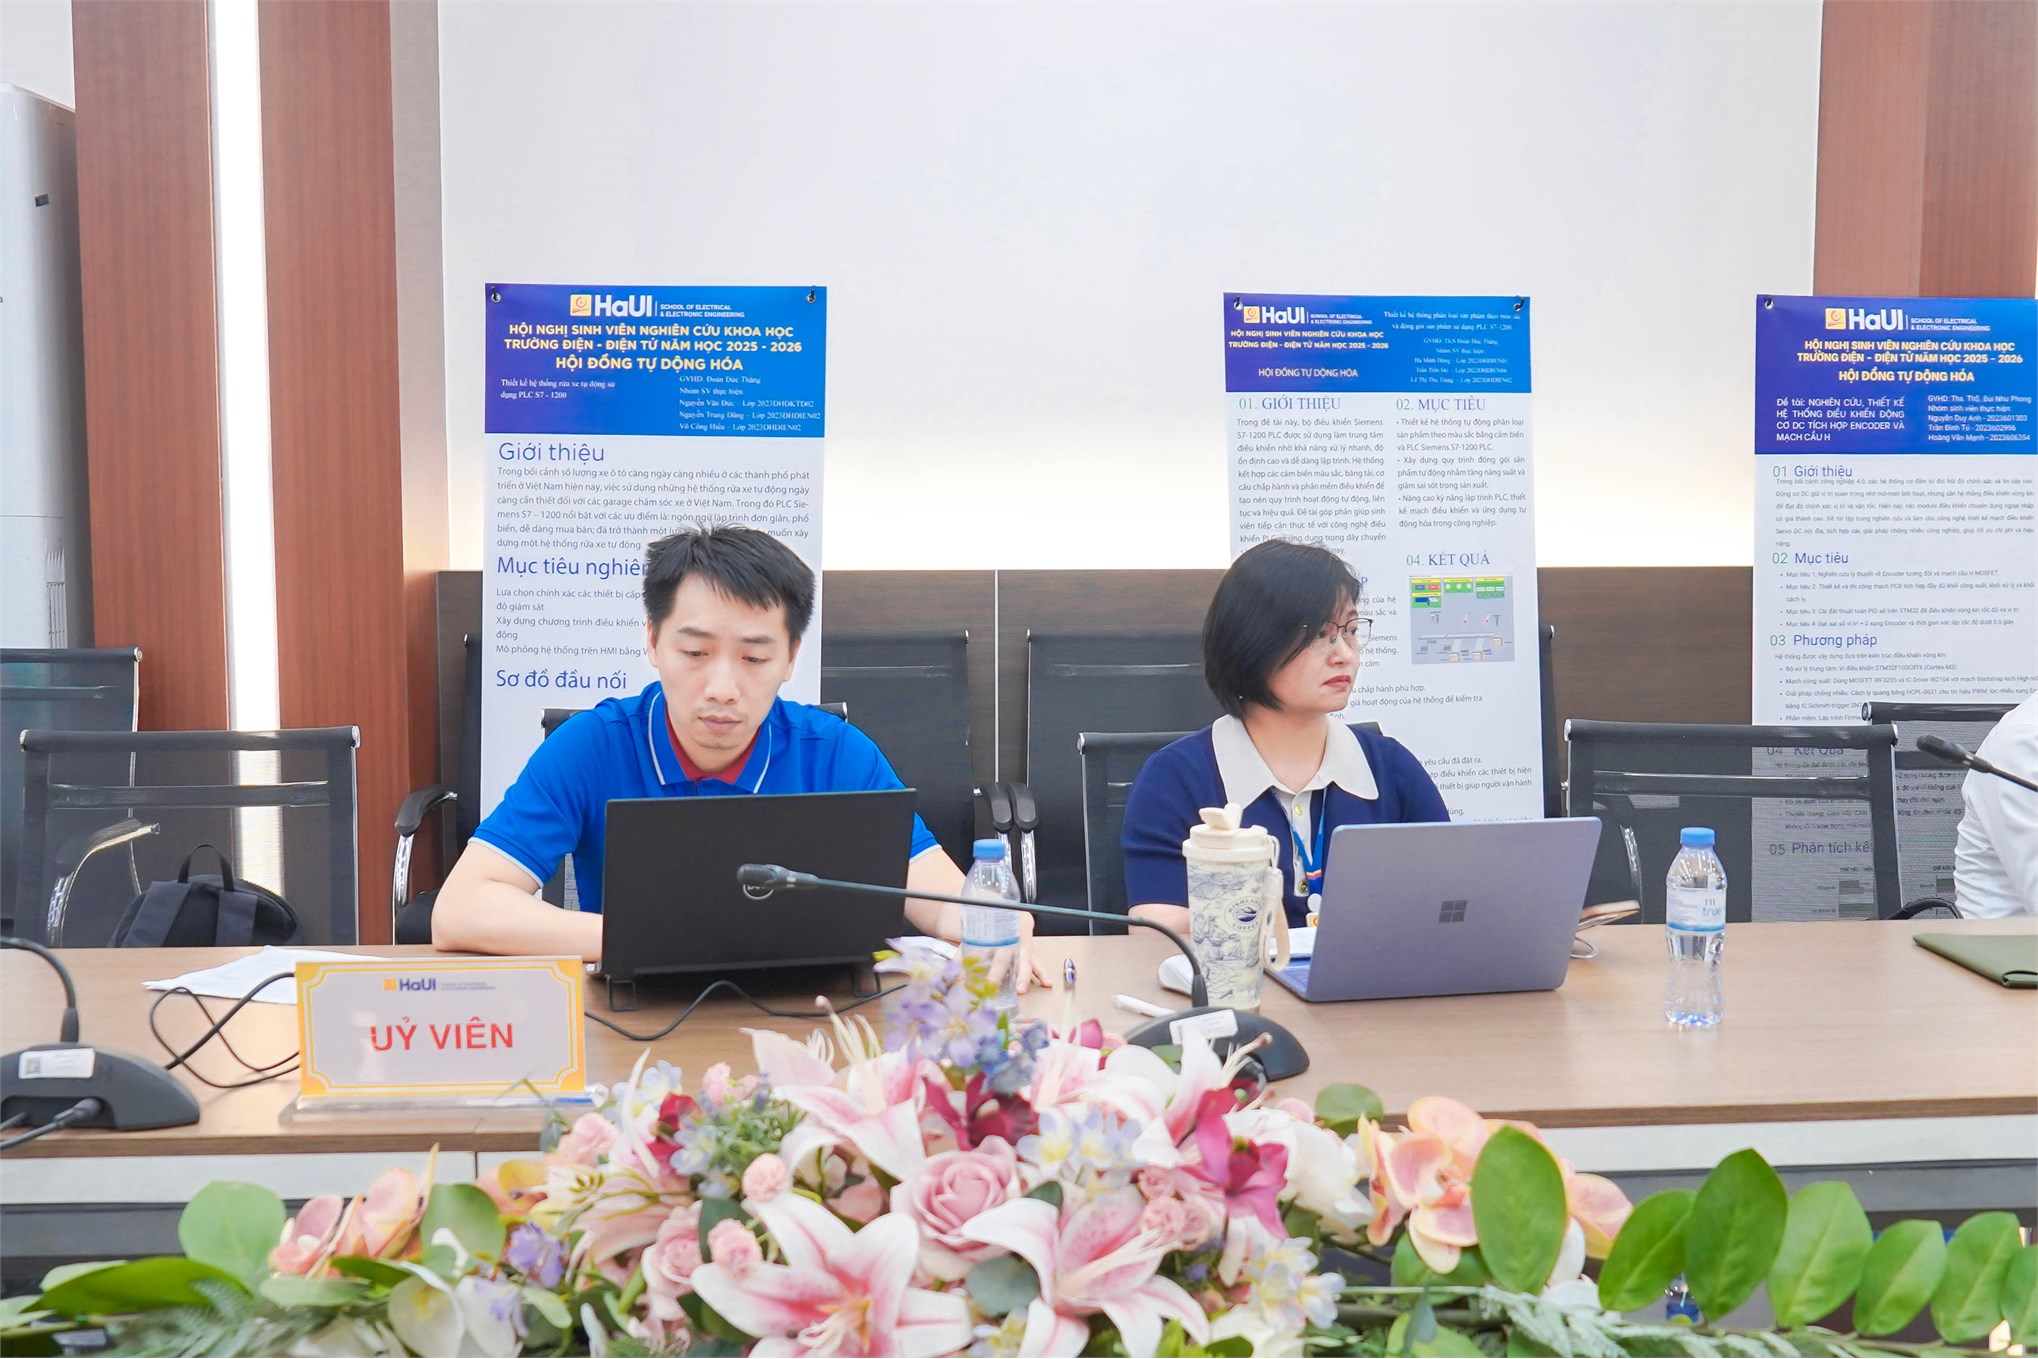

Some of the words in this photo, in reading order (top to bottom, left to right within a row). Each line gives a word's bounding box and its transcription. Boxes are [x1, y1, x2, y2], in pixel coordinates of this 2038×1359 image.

[595, 295, 652, 317] HaUI
[1262, 306, 1305, 324] HaUI
[1849, 308, 1903, 331] HaUI
[509, 322, 533, 338] HỘI
[532, 324, 568, 338] NGHỊ
[571, 325, 602, 335] SINH
[605, 322, 636, 336] VIÊN
[640, 323, 690, 336] NGHIÊN
[693, 324, 720, 336] CỨU
[724, 326, 762, 336] KHOA
[765, 327, 794, 339] HỌC
[1231, 328, 1245, 338] HỘI
[1283, 329, 1301, 337] VIÊN
[504, 337, 559, 350] TRƯỜNG
[562, 337, 594, 353] ĐIỆN
[605, 338, 637, 353] ĐIỆN
[640, 339, 658, 351] TỬ
[661, 338, 691, 351] NĂM
[694, 341, 722, 354] HỌC
[726, 341, 758, 352] 2025
[770, 341, 802, 352] 2026
[1228, 340, 1259, 348] TRƯỜNG
[1260, 340, 1278, 349] ĐIỆN
[1284, 341, 1302, 349] ĐIỆN
[1303, 340, 1313, 348] TỬ
[1804, 339, 1824, 353] HỘI
[1824, 341, 1850, 352] NGHỊ
[1851, 341, 1875, 350] SINH
[1876, 339, 1900, 350] VIÊN
[1901, 340, 1939, 351] NGHIÊN
[1940, 339, 1962, 351] CỨU
[1963, 342, 1992, 351] KHOA
[1993, 342, 2015, 353] HỌC
[556, 354, 583, 372] HỘI
[587, 353, 633, 370] ĐỒNG
[636, 357, 657, 373] TỰ
[710, 356, 743, 370] HÓA
[1797, 351, 1839, 362] TRƯỜNG
[1840, 351, 1864, 364] ĐIỆN
[1874, 351, 1898, 365] ĐIỆN
[1915, 352, 1938, 363] NĂM
[1939, 354, 1961, 365] HỌC
[1963, 354, 1988, 363] 2025
[1998, 354, 2023, 363] 2026
[1258, 367, 1274, 378] HỘI
[1274, 367, 1300, 377] ĐỒNG
[1301, 368, 1312, 378] TỰ
[1340, 368, 1358, 377] HÓA
[1839, 368, 1859, 384] HỘI
[1861, 367, 1895, 381] ĐỒNG
[1897, 370, 1914, 384] TỰ
[1950, 368, 1974, 382] HÓA
[1239, 398, 1257, 409] 01.
[1262, 394, 1293, 409] GIỚI
[1297, 398, 1340, 412] THIỆU
[1396, 398, 1413, 410] 02.
[1418, 398, 1450, 413] MỤC
[1454, 395, 1485, 410] TIÊU
[1792, 398, 1805, 406] tài:
[1807, 397, 1841, 406] NGHIÊN
[1843, 396, 1864, 407] CỨU,
[1866, 396, 1890, 407] THIẾT
[1894, 396, 1904, 407] KẾ
[1776, 408, 1788, 420] HỆ
[1880, 409, 1904, 419] ĐỘNG
[1776, 421, 1790, 430] CƠ
[1792, 421, 1805, 430] DC
[1808, 420, 1828, 429] TÍCH
[1830, 421, 1848, 431] HỢP
[1850, 422, 1891, 430] ENCODER
[1776, 433, 1803, 443] MẠCH
[499, 442, 541, 461] Giới
[549, 443, 604, 465] thiệu
[1773, 466, 1786, 477] 01
[1794, 465, 1818, 477] Giới
[1822, 465, 1852, 479] thiệu
[1407, 555, 1424, 565] 04.
[1429, 550, 1456, 566] KẾT
[1772, 552, 1788, 564] 02
[1795, 552, 1822, 566] Mục
[1825, 552, 1848, 564] tiêu
[498, 556, 537, 578] Mục
[543, 557, 579, 575] tiêu
[497, 588, 511, 597] Lựa
[513, 588, 534, 597] chọn
[536, 588, 560, 597] chính
[562, 589, 576, 598] xác
[594, 589, 613, 598] thiết
[616, 590, 623, 598] bị
[626, 590, 643, 600] cấp
[1770, 634, 1786, 646] 03
[1794, 634, 1842, 648] Phương
[1847, 633, 1877, 648] pháp
[497, 669, 520, 687] Sơ
[525, 668, 549, 688] đồ
[555, 669, 590, 688] đầu
[598, 670, 626, 689] nối
[1358, 685, 1375, 694] chấp
[1395, 685, 1409, 693] phù
[1410, 684, 1426, 692] hợp.
[400, 979, 436, 991] HaUI
[371, 1016, 417, 1051] UỶ
[429, 1016, 513, 1050] VIÊN
